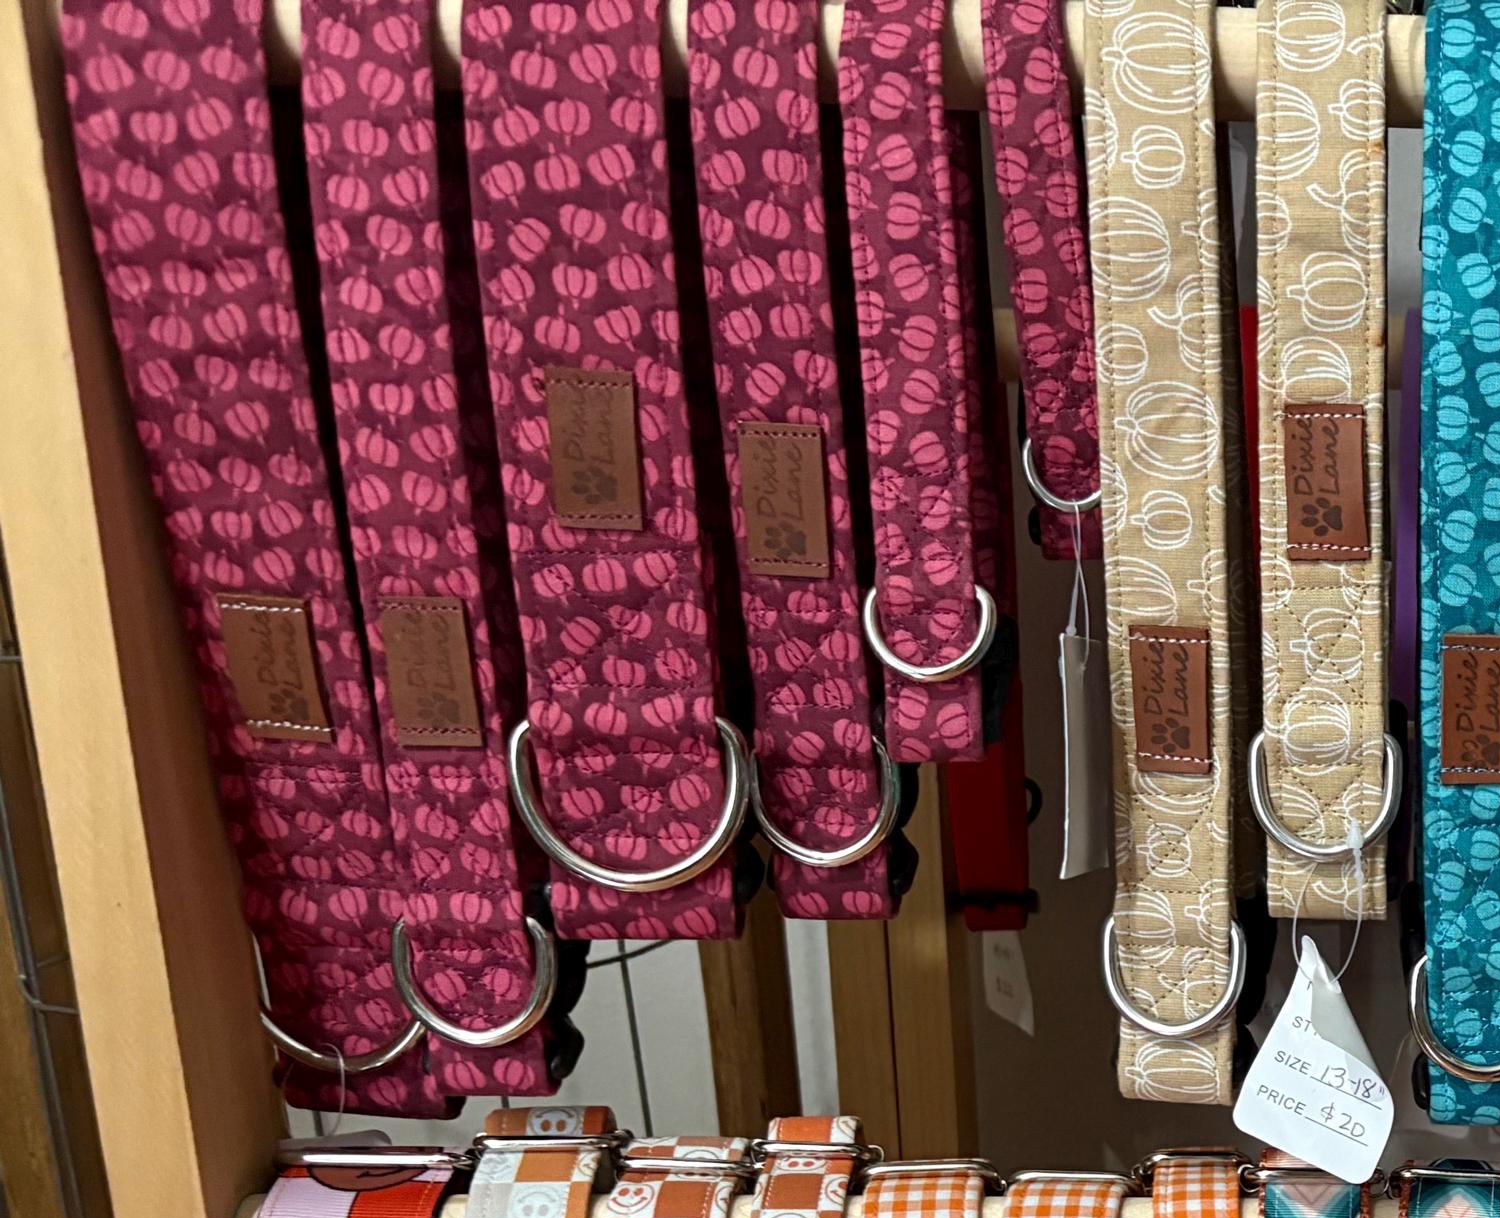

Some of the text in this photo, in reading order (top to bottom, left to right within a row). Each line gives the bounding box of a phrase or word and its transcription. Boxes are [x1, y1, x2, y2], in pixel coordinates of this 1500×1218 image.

[1294, 418, 1313, 497] Dixie
[1319, 416, 1341, 495] Lane
[1143, 641, 1165, 715] Dixie
[1168, 644, 1190, 717] Lane
[1456, 652, 1480, 733] Dixie
[1274, 1050, 1312, 1075] SIZE
[1256, 1085, 1307, 1116] PRICE
